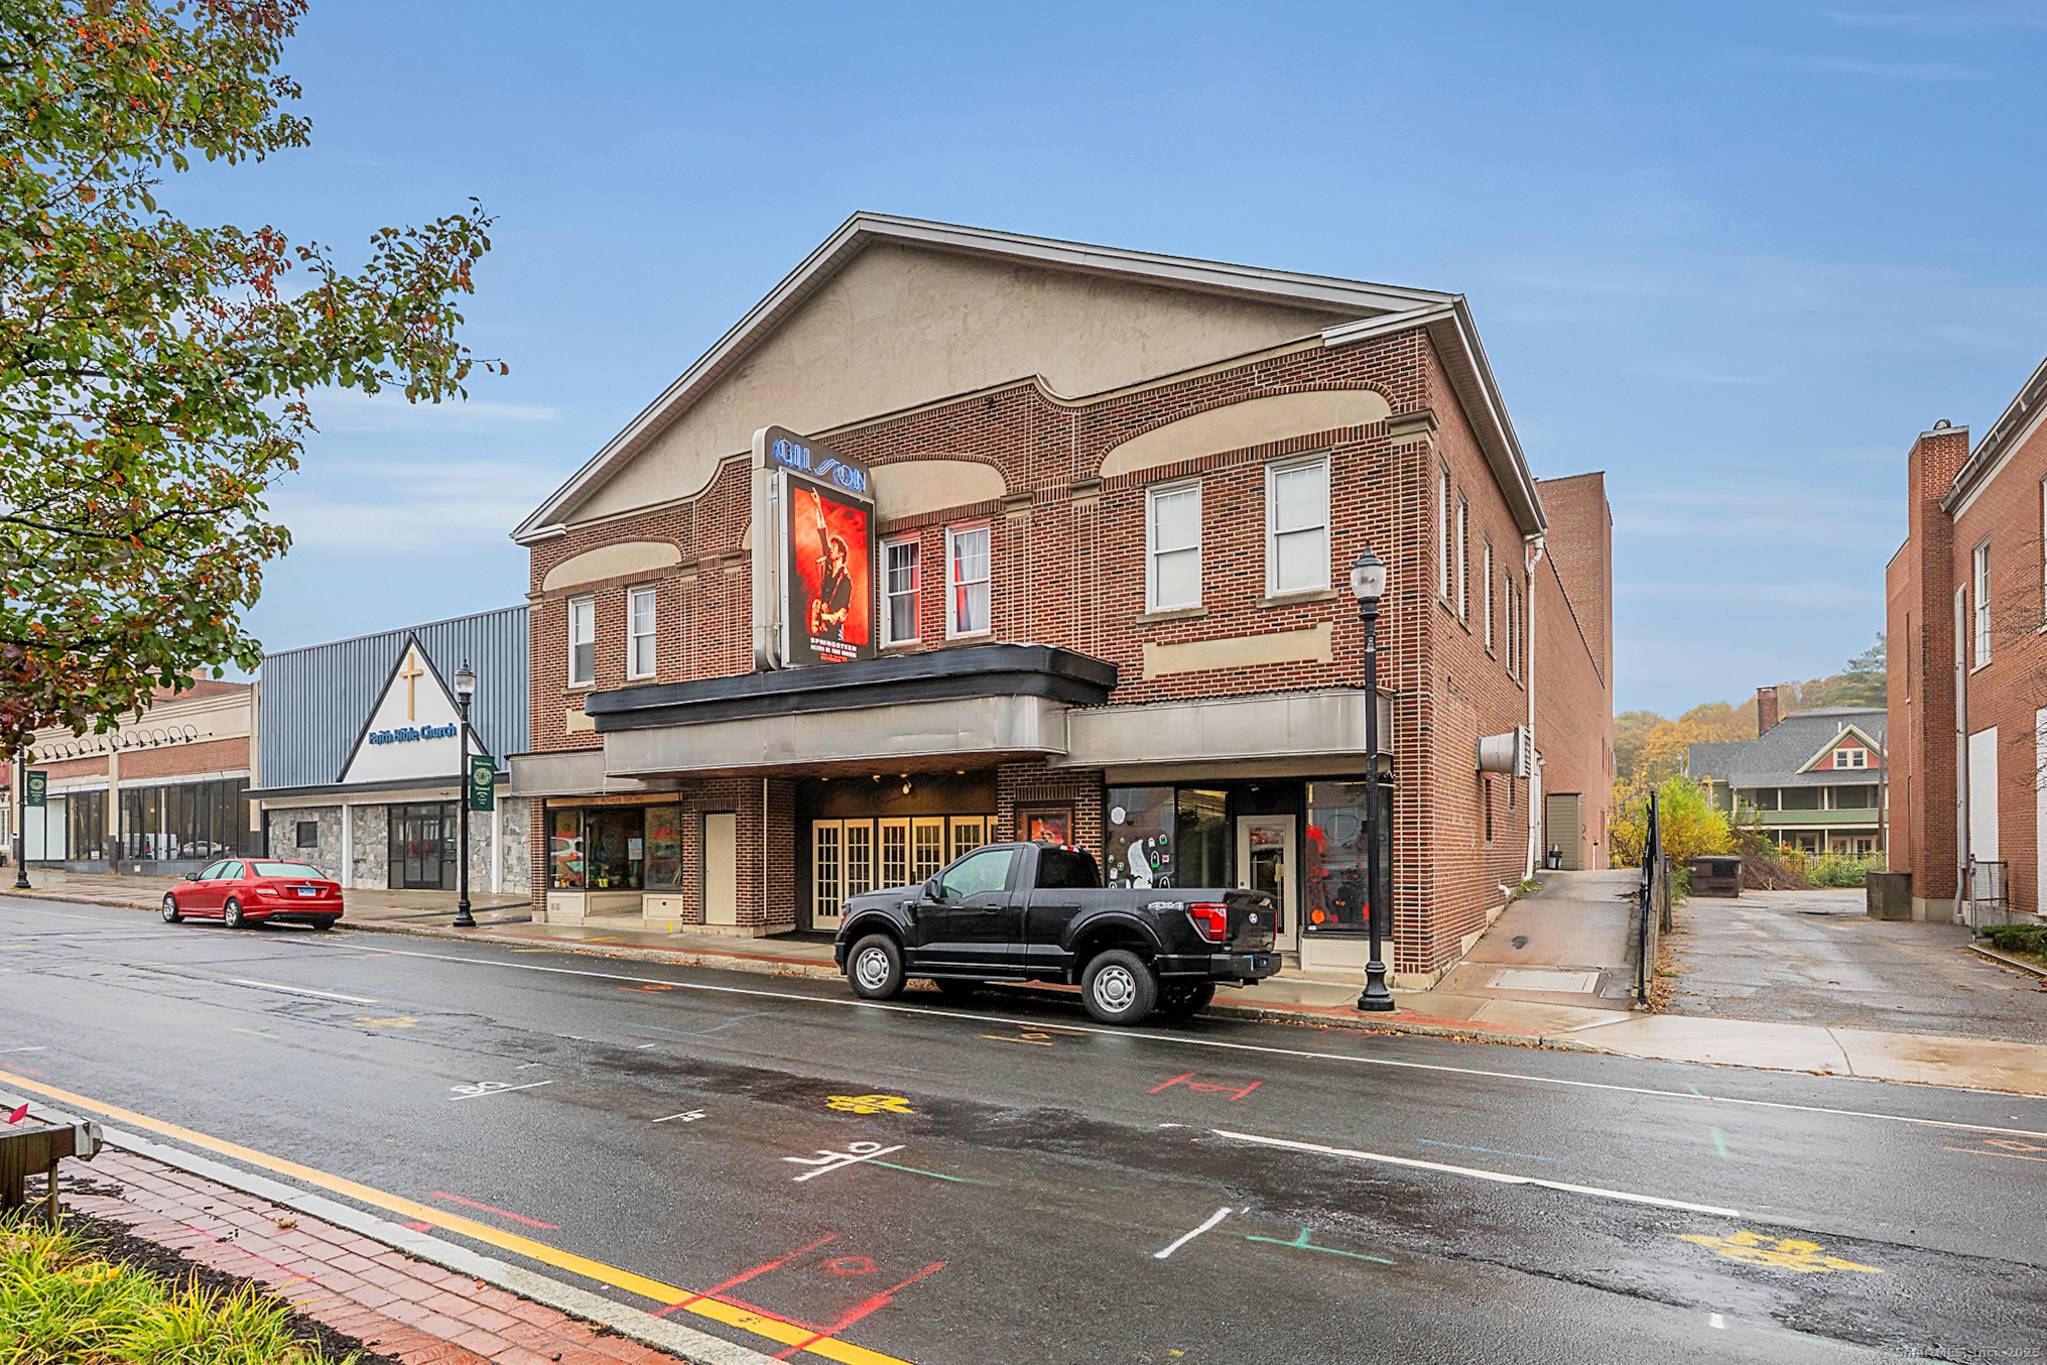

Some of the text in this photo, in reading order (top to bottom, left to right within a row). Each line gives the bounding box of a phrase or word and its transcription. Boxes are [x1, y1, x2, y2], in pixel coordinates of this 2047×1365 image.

[368, 722, 457, 745] Faith Bible Church
